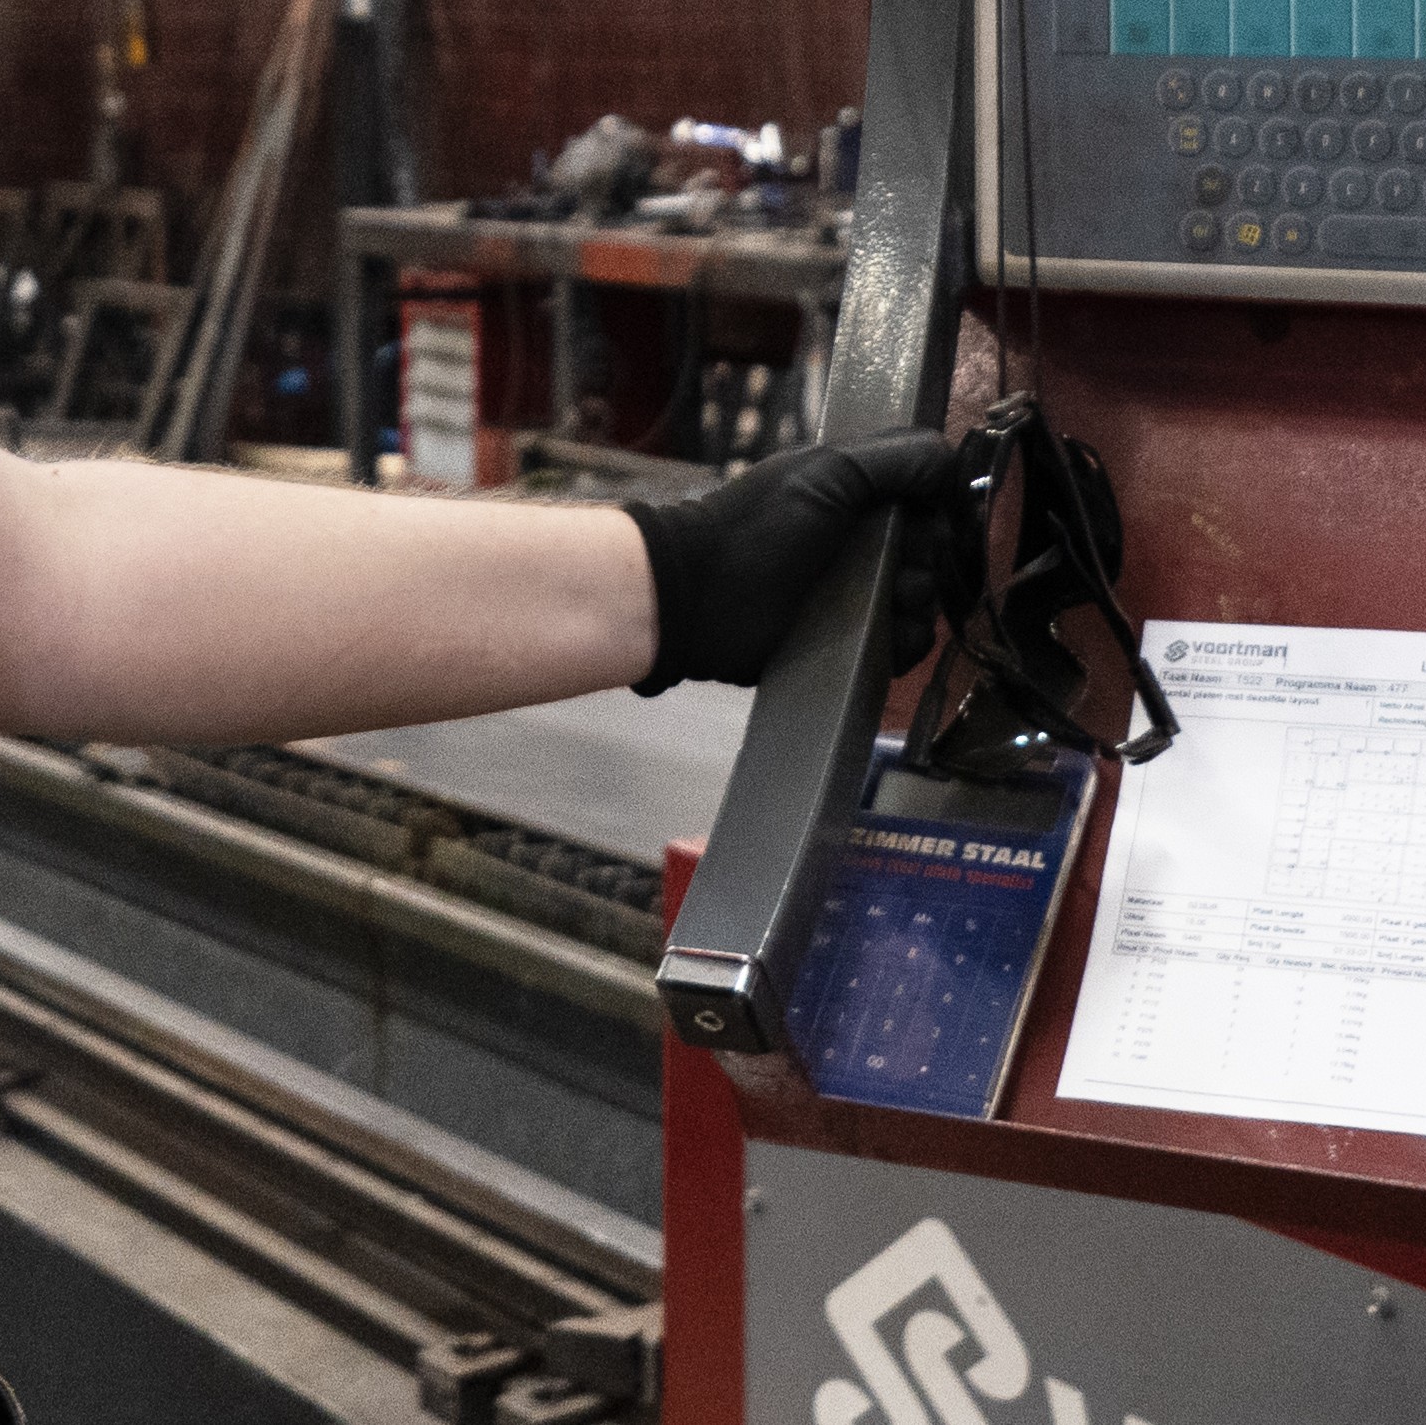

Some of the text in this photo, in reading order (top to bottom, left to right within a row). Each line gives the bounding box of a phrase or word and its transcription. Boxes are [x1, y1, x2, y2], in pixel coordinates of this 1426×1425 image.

[1191, 639, 1288, 659] voortman
[1190, 674, 1222, 685] Naam
[1275, 677, 1340, 693] Programma
[1343, 680, 1378, 693] Naam
[849, 827, 1046, 871] ZIMMER STAAL
